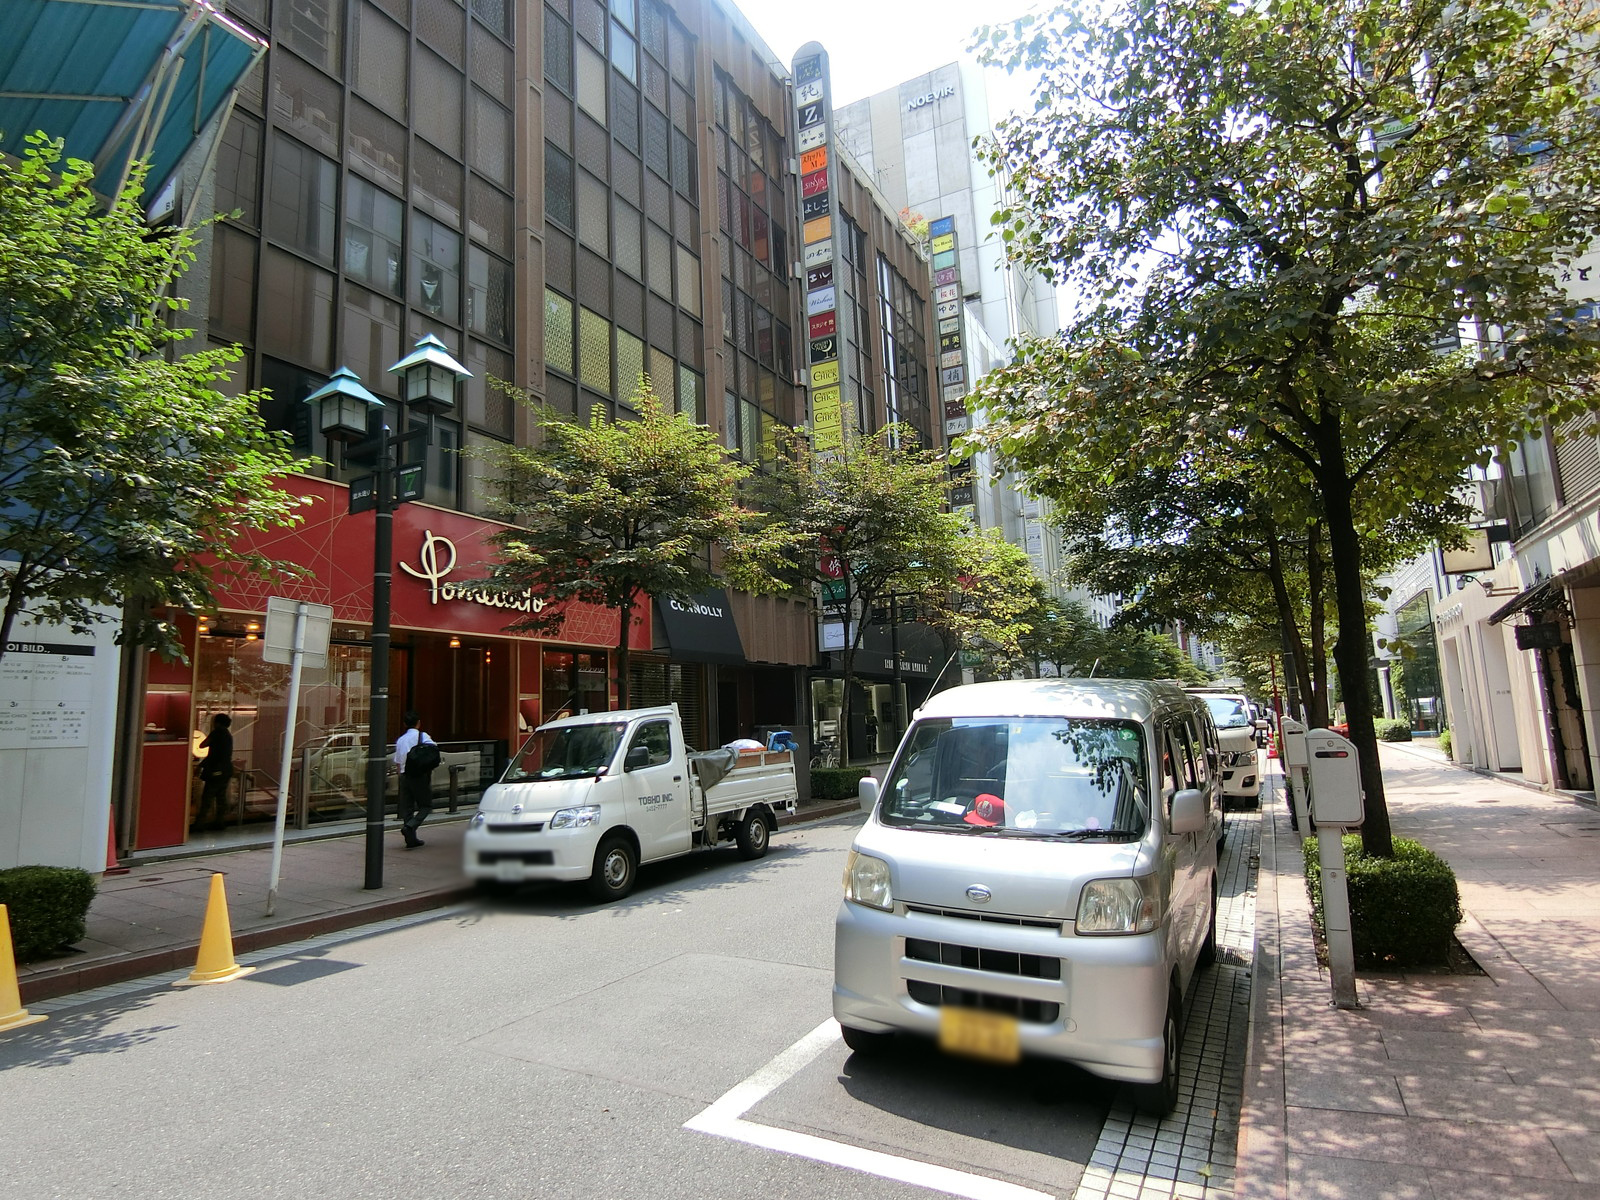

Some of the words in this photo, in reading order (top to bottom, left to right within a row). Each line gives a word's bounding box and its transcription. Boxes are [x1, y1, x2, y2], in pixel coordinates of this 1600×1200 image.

[907, 86, 955, 112] NOEVIR
[805, 106, 818, 125] Z
[804, 199, 829, 214] よしこ
[813, 370, 838, 382] CHICK
[405, 473, 416, 491] 7
[638, 795, 660, 806] TOSHO
